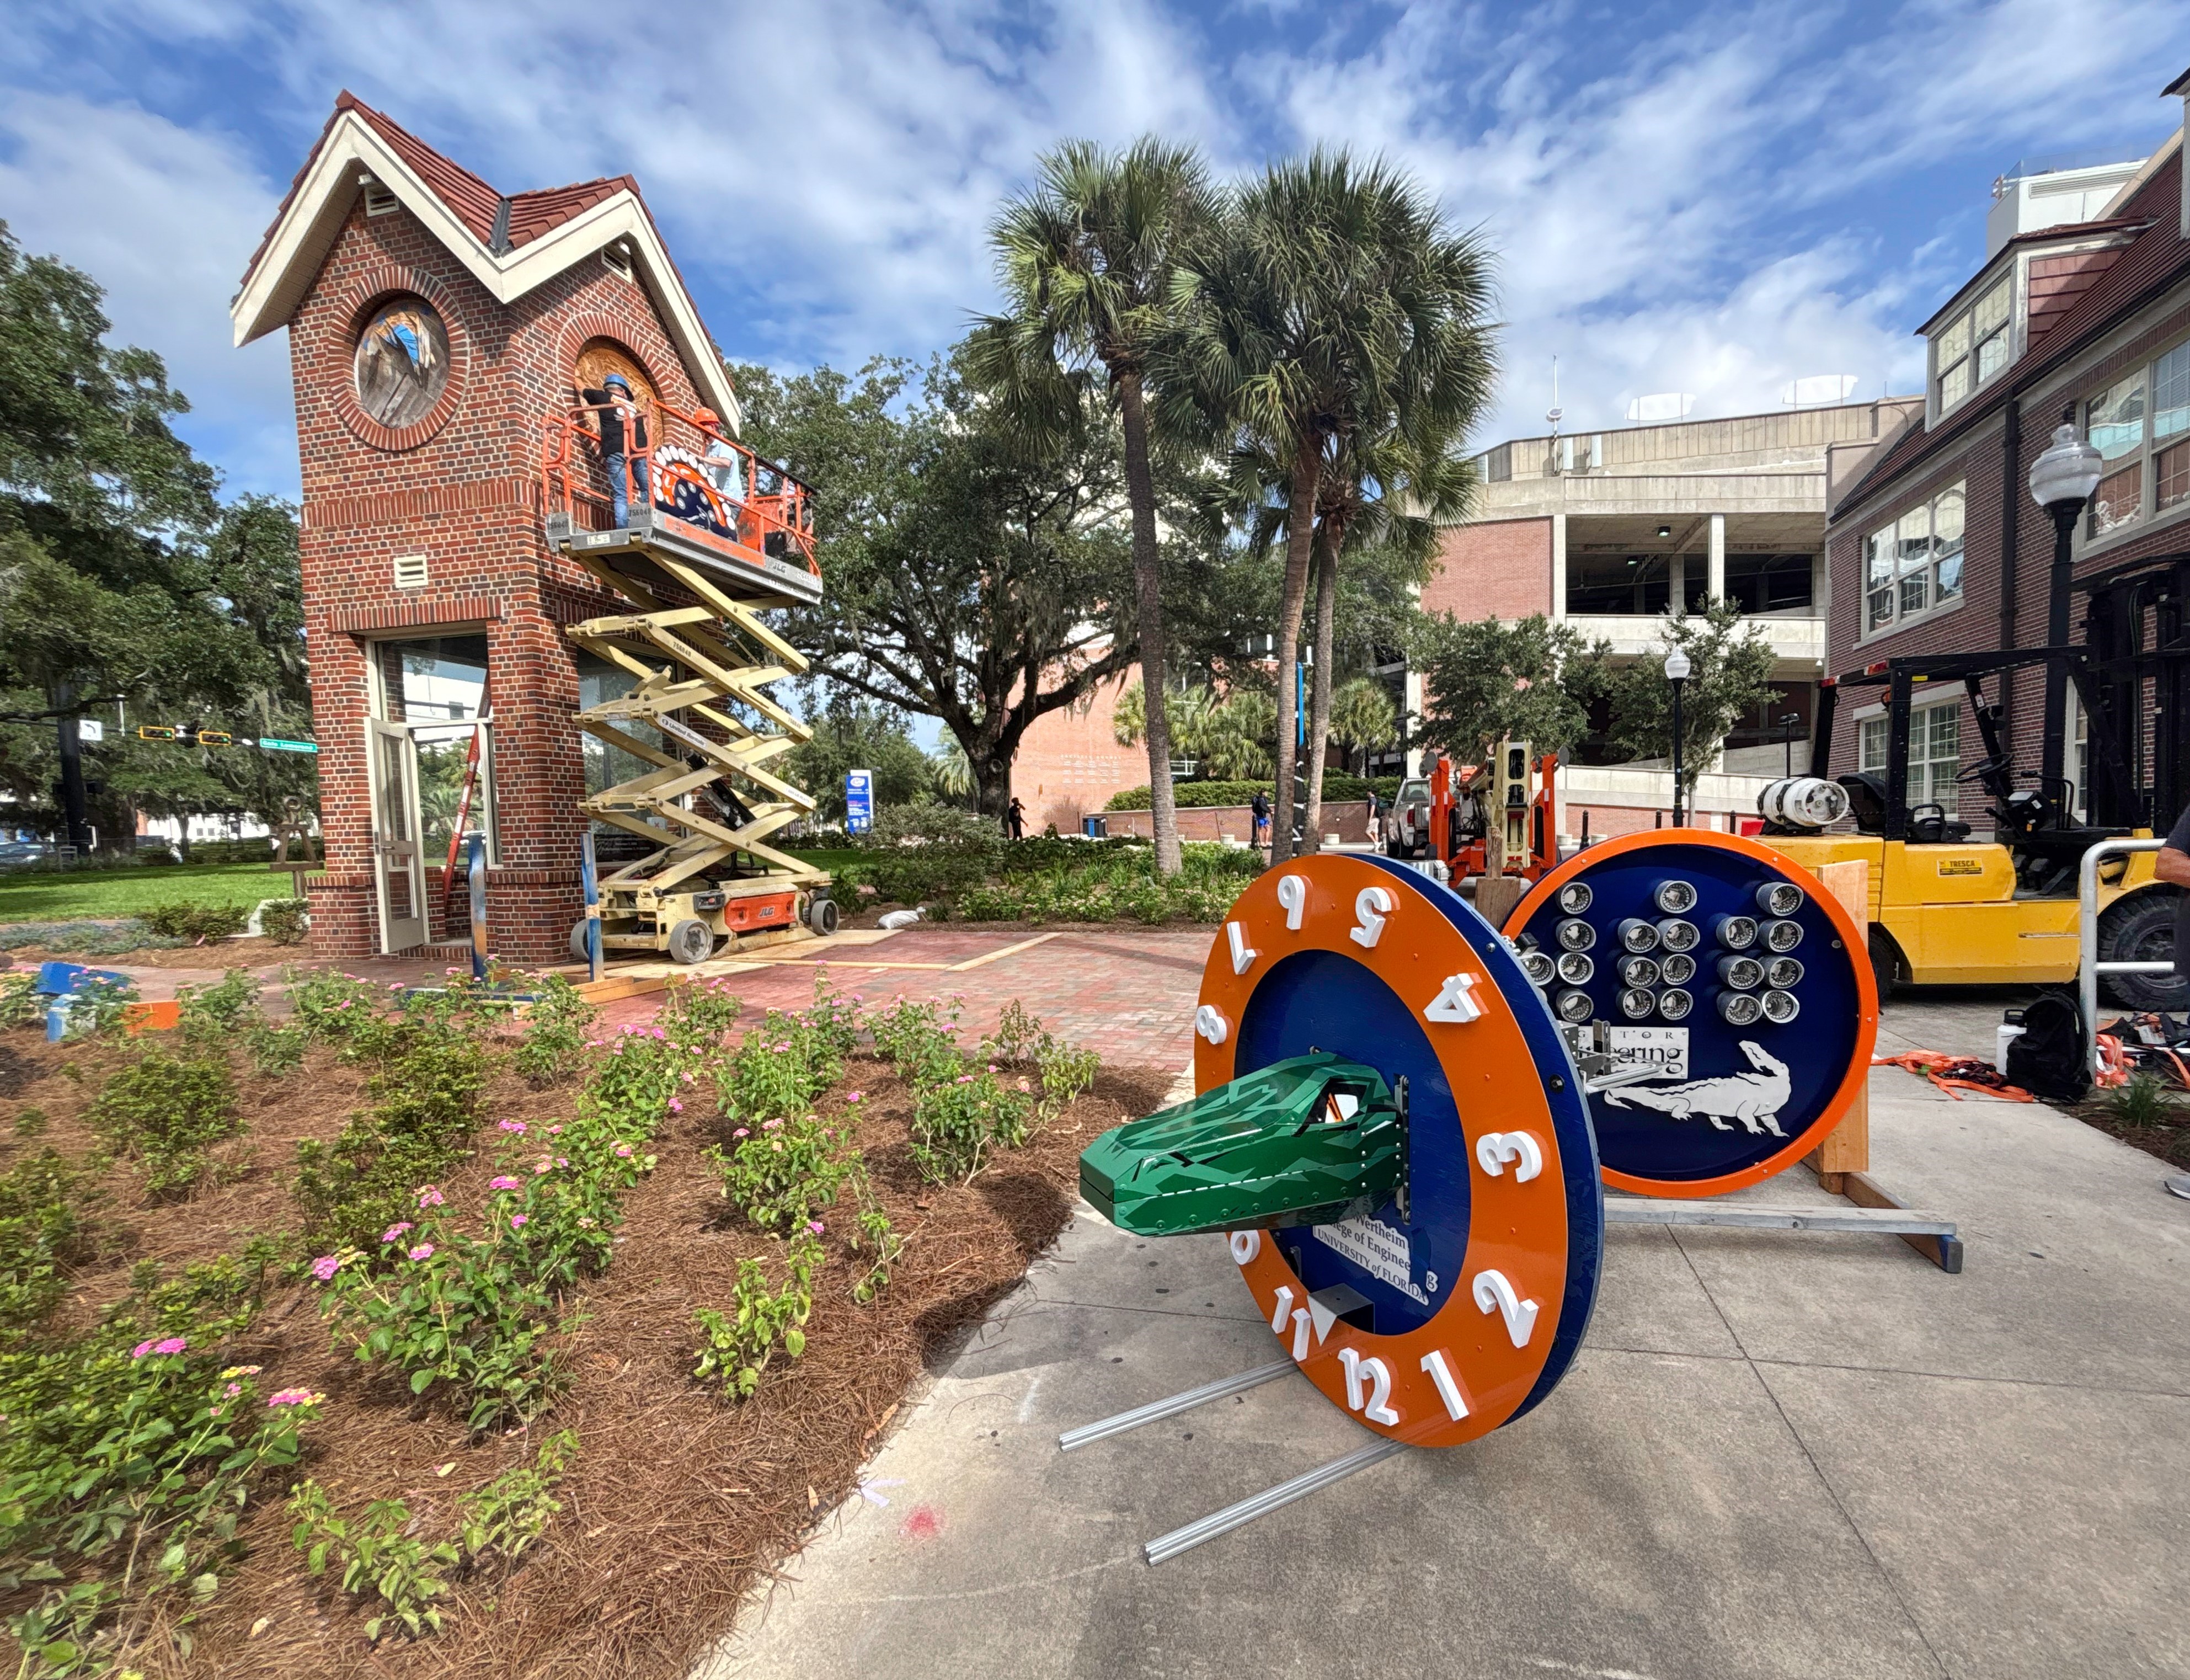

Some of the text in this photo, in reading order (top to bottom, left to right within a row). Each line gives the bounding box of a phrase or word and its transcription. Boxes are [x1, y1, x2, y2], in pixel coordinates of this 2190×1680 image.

[772, 562, 787, 573] JLG
[669, 722, 705, 746] United Rentals
[759, 906, 774, 918] JLG
[1278, 875, 1305, 930] 6
[1350, 887, 1392, 948] 5
[1226, 921, 1258, 975] 7
[1195, 1005, 1227, 1044] 8
[1423, 973, 1482, 1023] 4
[1476, 1130, 1542, 1183] 3
[1230, 1230, 1260, 1265] 0
[1318, 1228, 1426, 1303] UNIVERSITY of FLORIDA
[1354, 1232, 1365, 1246] of
[1272, 1286, 1312, 1362] 11
[1472, 1269, 1539, 1348] 2
[1337, 1347, 1400, 1426] 12
[1420, 1350, 1470, 1421] 1
